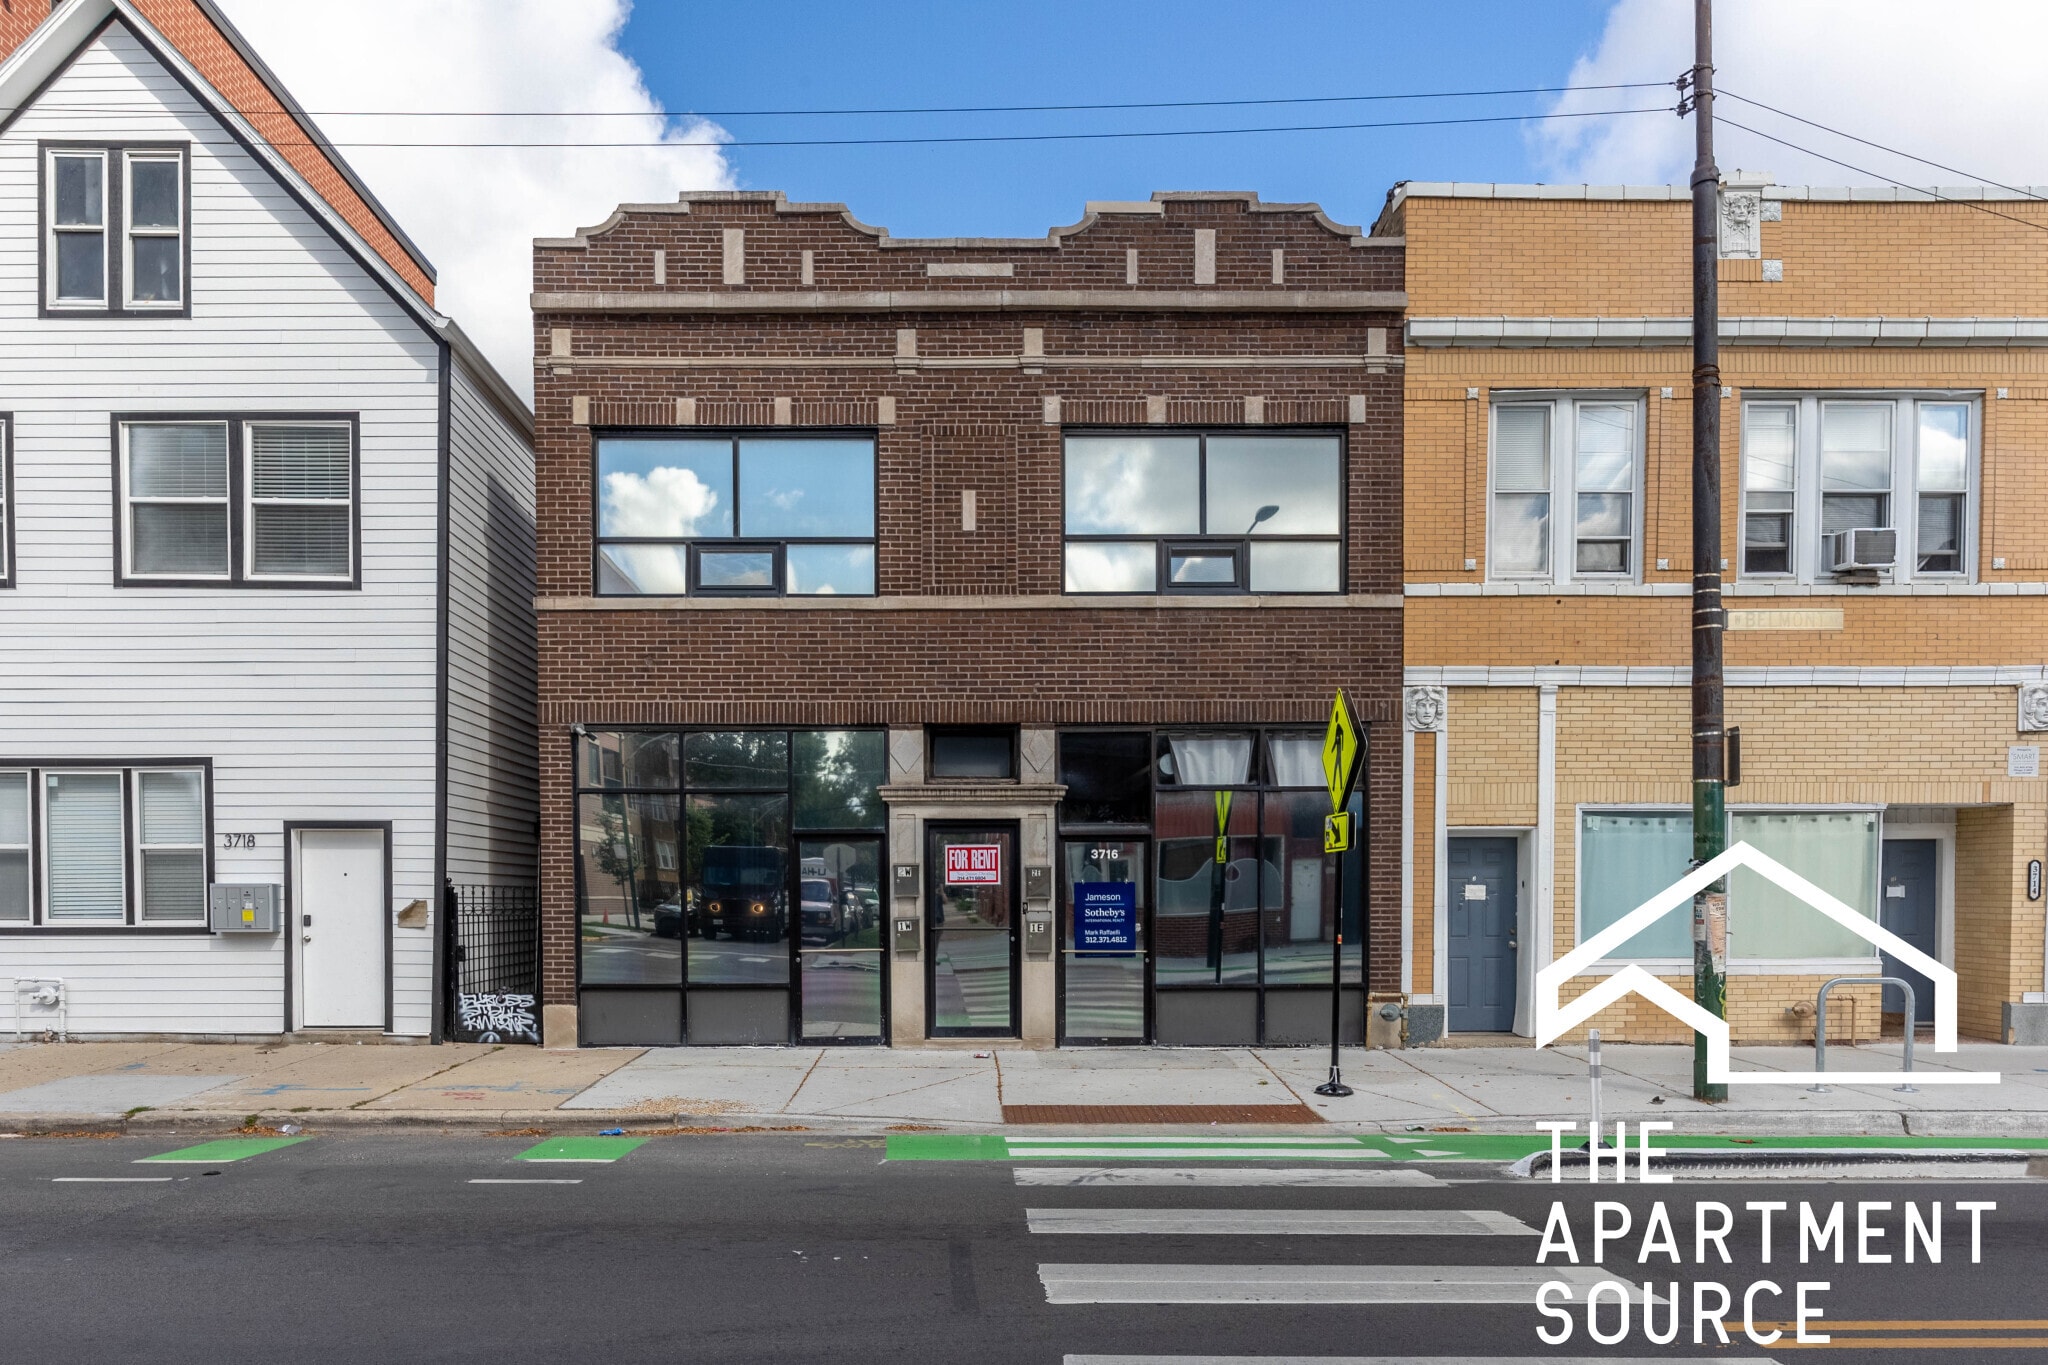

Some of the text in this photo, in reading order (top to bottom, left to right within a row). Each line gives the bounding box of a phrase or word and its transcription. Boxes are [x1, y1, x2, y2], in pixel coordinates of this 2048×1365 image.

[1745, 611, 1824, 628] BELMONT
[223, 833, 256, 850] 3718
[949, 849, 997, 870] FOR RENT
[1090, 849, 1119, 859] 3716
[1085, 893, 1121, 901] Jameson
[1085, 908, 1126, 918] Sotheby's
